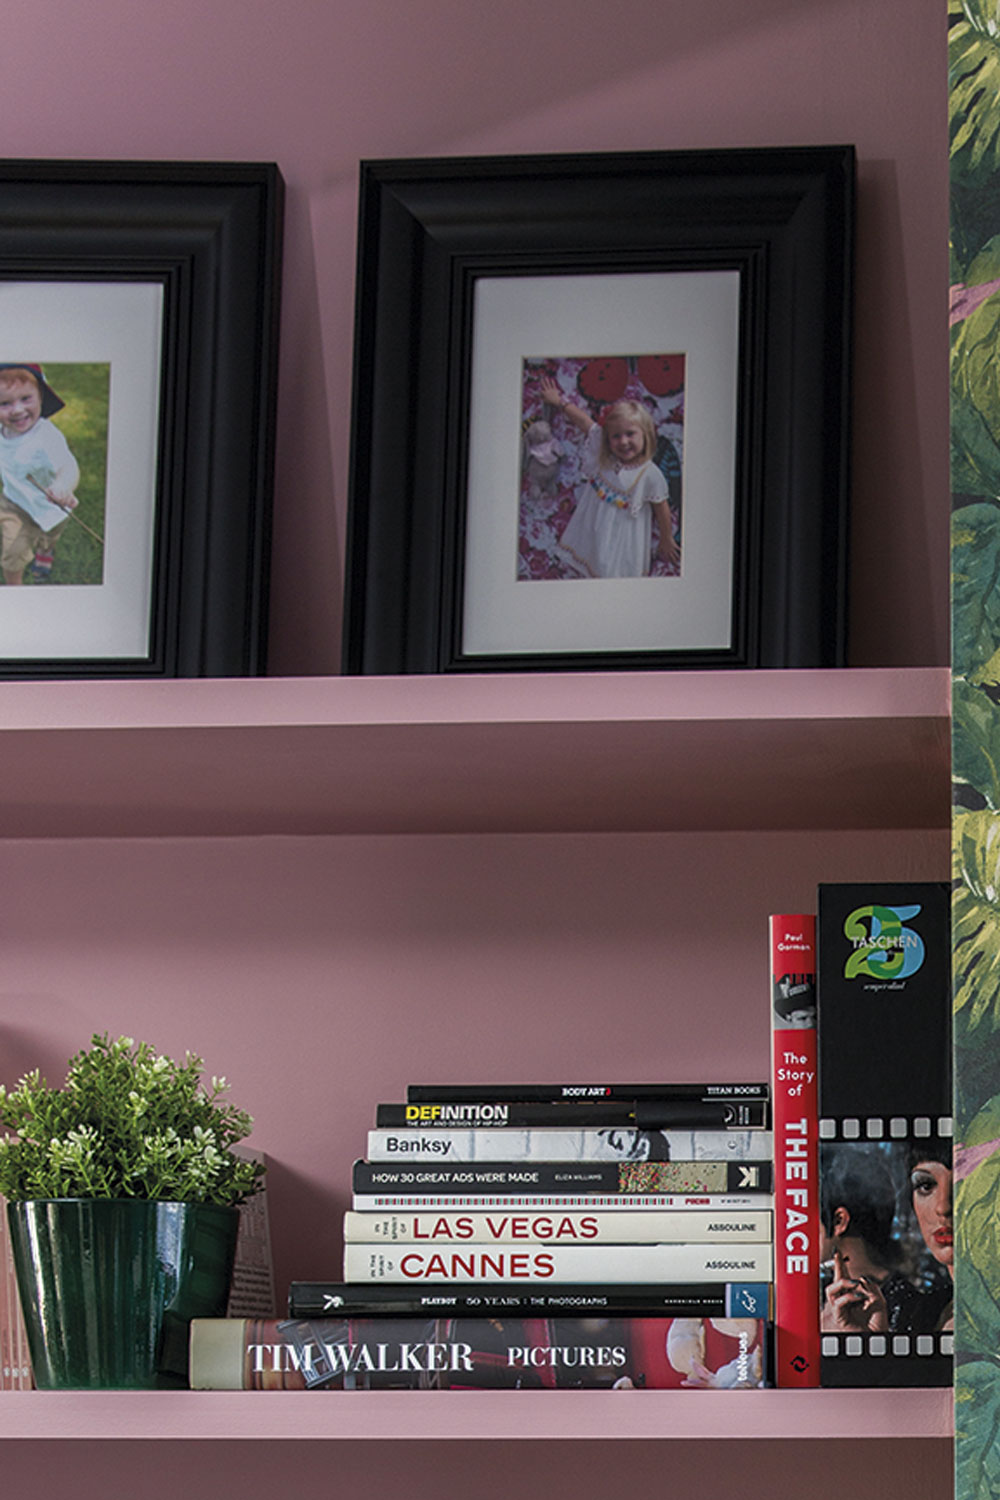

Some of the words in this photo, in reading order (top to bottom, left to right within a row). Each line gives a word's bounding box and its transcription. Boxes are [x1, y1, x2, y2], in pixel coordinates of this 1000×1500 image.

[785, 933, 803, 941] Paul
[851, 936, 918, 949] TASCHEN
[777, 943, 810, 951] Gorman
[783, 1052, 808, 1065] The
[777, 1069, 815, 1084] Story
[562, 1087, 587, 1096] BODY
[587, 1087, 605, 1096] ART
[707, 1086, 732, 1095] TITAN
[734, 1086, 761, 1095] BOOKS
[787, 1083, 803, 1097] of
[405, 1104, 509, 1120] DEFINITION
[386, 1137, 452, 1156] Banksy
[785, 1118, 808, 1180] THE
[372, 1173, 399, 1183] HOW
[400, 1173, 414, 1183] 30
[416, 1173, 450, 1183] GREAT
[452, 1173, 474, 1183] ADS
[475, 1173, 506, 1183] WERE
[508, 1173, 539, 1183] MADE
[413, 1217, 474, 1239] LAS
[485, 1217, 599, 1239] VEGAS
[707, 1223, 757, 1232] ASSOULINE
[785, 1188, 810, 1274] FACE
[400, 1253, 555, 1279] CANNES
[705, 1261, 756, 1270] ASSOULINE
[421, 1297, 457, 1306] PLAYBOY
[466, 1297, 481, 1306] 50
[484, 1297, 521, 1306] YEARS
[531, 1297, 545, 1306] THE
[548, 1297, 608, 1306] PHOTOGRAPHS
[247, 1343, 315, 1373] TIM
[324, 1343, 475, 1373] WALKER
[507, 1347, 627, 1367] PICTURES
